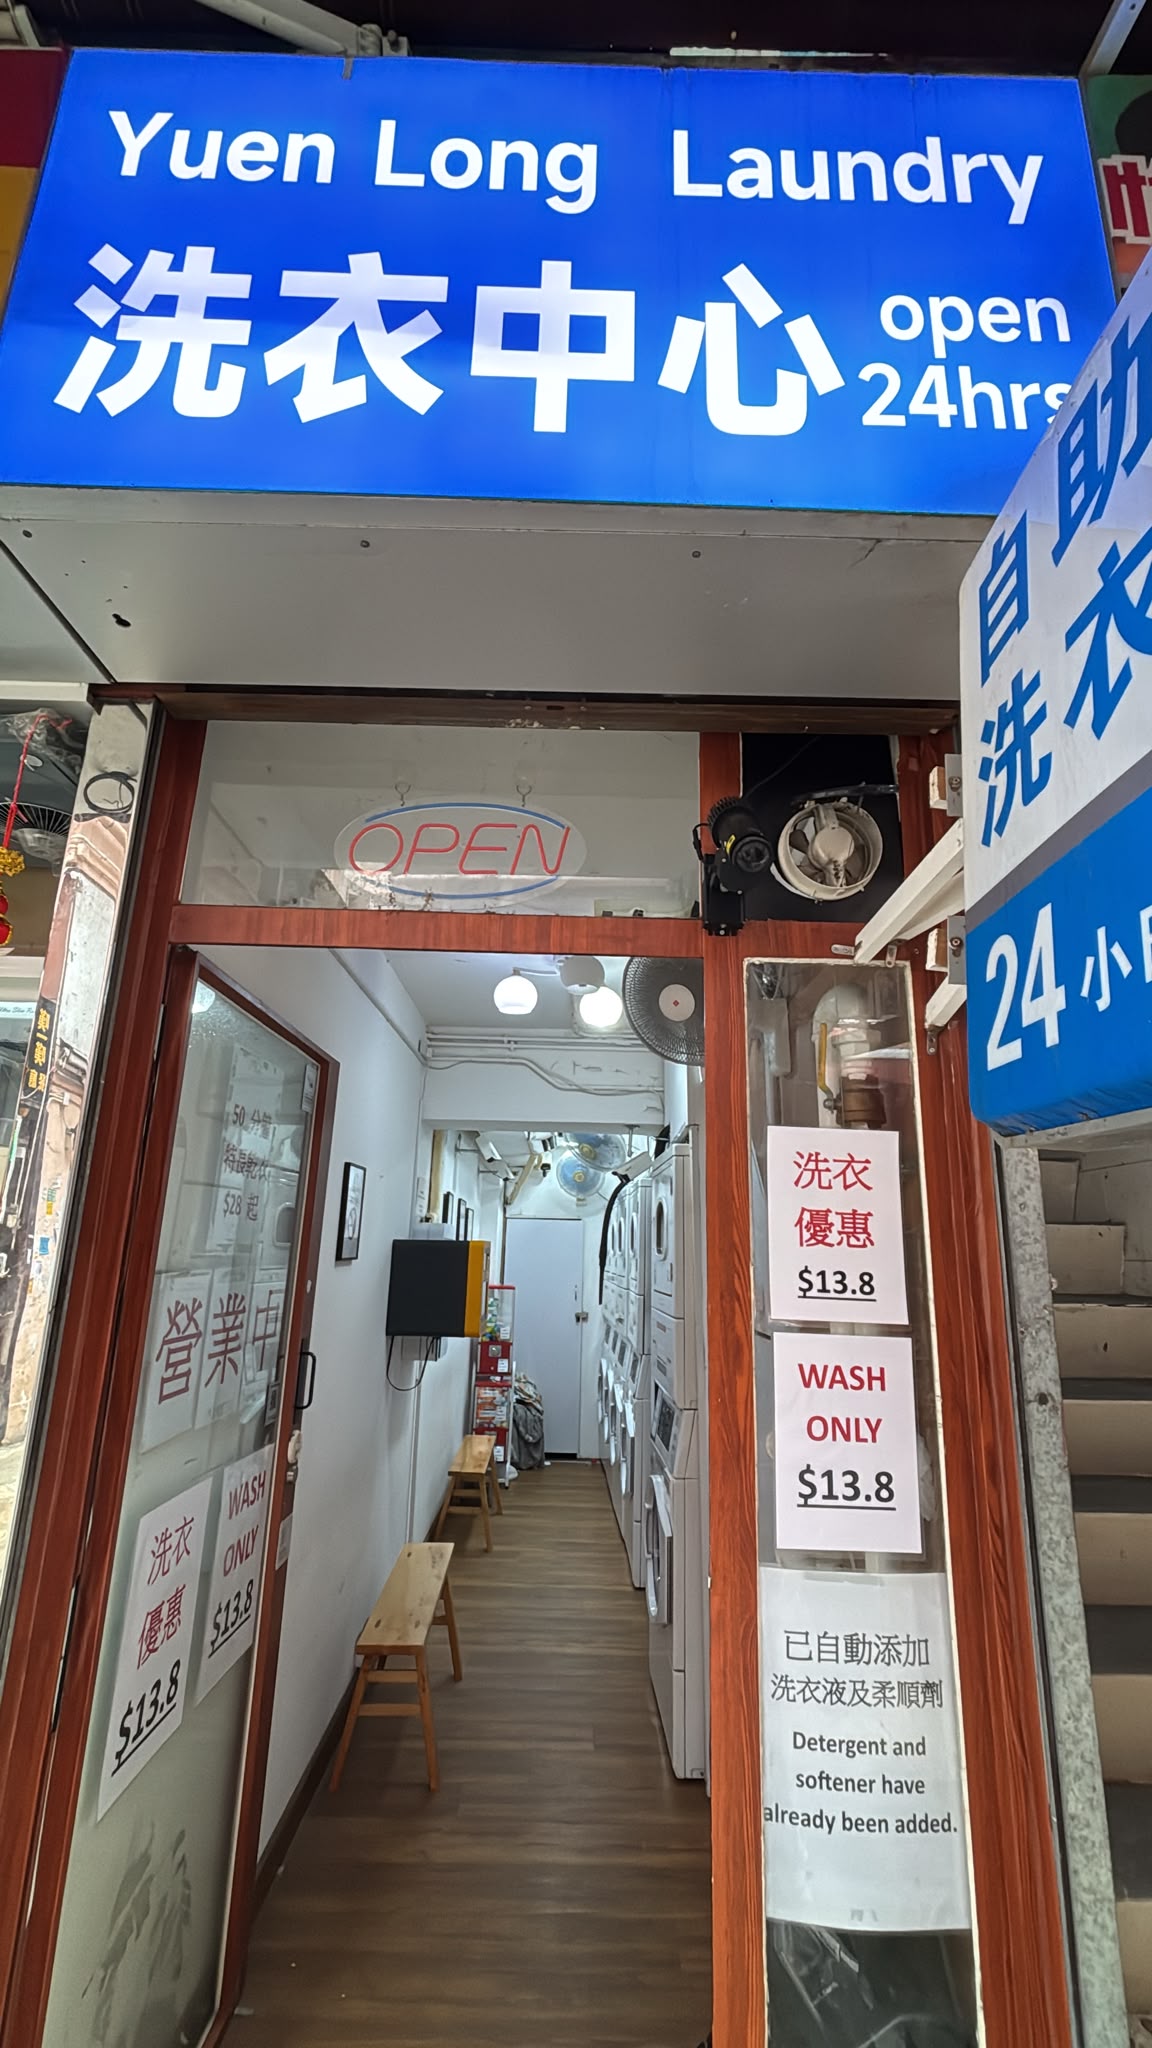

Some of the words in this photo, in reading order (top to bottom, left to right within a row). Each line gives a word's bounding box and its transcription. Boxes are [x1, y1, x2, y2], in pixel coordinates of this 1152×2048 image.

[108, 110, 335, 184] Yuen
[374, 119, 598, 214] Long
[672, 129, 1044, 225] Laundry
[53, 243, 846, 436] 洗衣中心
[880, 294, 1071, 359] open
[348, 822, 571, 876] OPEN
[793, 1150, 874, 1192] 洗衣
[794, 1207, 876, 1250] 優惠
[797, 1265, 876, 1298] $13.8
[155, 1288, 286, 1405] 營業中
[798, 1363, 887, 1393] WASH
[806, 1415, 882, 1444] ONLY
[228, 1470, 267, 1521] WASH
[797, 1463, 895, 1505] $13.8
[147, 1515, 195, 1587] 洗衣
[223, 1524, 260, 1578] ONLY
[136, 1583, 187, 1671] 優惠
[210, 1578, 254, 1652] $13.8
[784, 1629, 931, 1668] 已自動添加
[115, 1658, 181, 1768] $13.8
[770, 1673, 944, 1709] 洗衣液及柔順劑
[793, 1731, 887, 1759] Detergent
[892, 1736, 927, 1757] and
[795, 1770, 876, 1795] softener
[881, 1774, 926, 1795] have
[763, 1804, 836, 1837] already
[842, 1810, 889, 1834] been
[894, 1812, 958, 1835] added.
